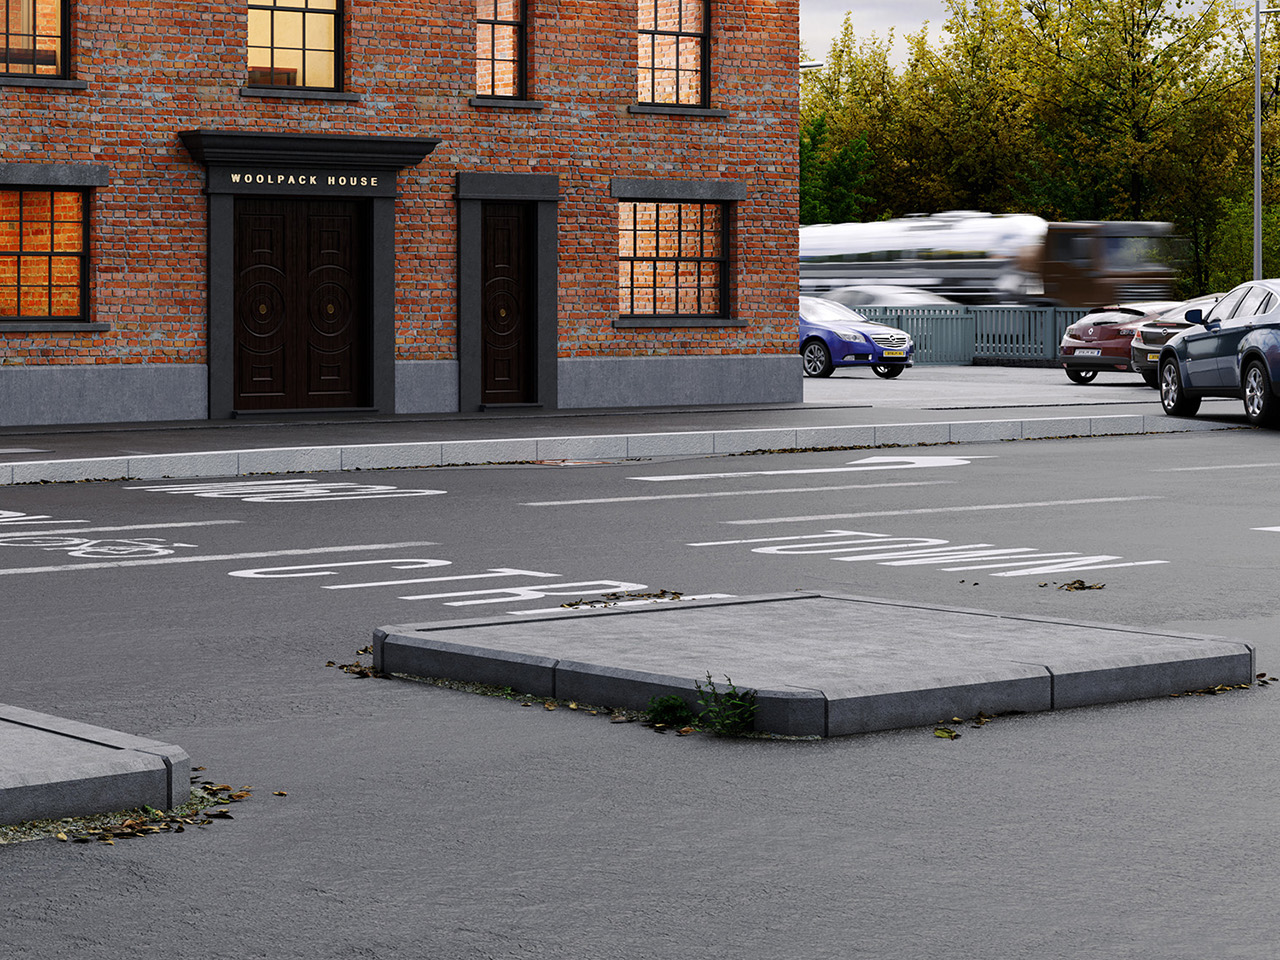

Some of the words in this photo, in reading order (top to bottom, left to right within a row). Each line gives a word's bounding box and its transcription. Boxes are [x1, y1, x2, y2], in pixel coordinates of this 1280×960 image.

[230, 173, 317, 185] WOOLPACK
[328, 176, 379, 187] HOUSE
[685, 529, 1171, 577] TOWN
[227, 558, 650, 607] CTR
